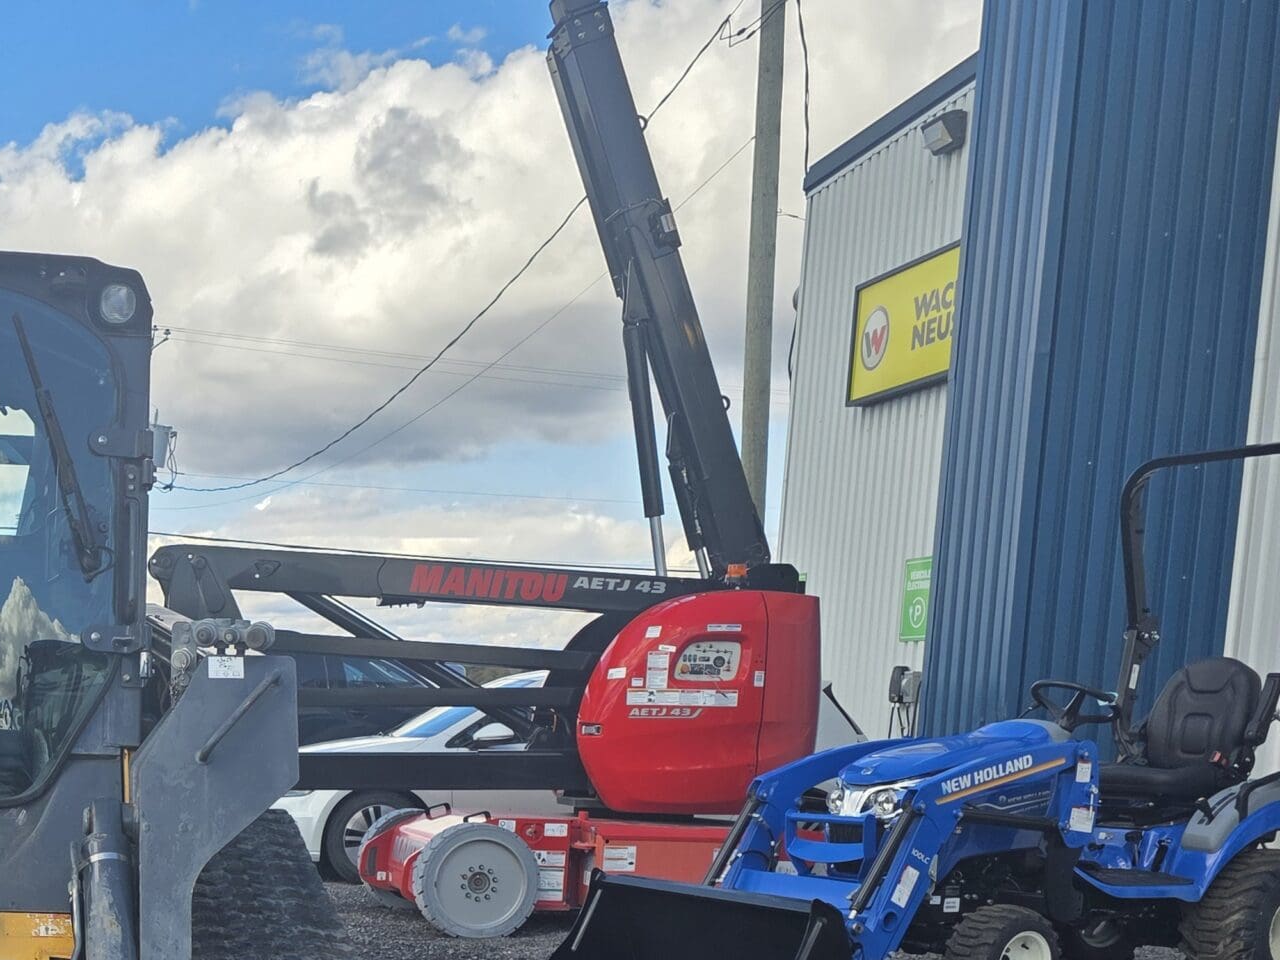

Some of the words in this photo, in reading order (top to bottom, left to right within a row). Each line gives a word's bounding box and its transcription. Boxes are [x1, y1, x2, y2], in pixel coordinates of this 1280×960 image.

[409, 563, 569, 602] MANITOU
[573, 576, 631, 592] AETJ
[634, 580, 667, 594] 43
[629, 707, 667, 716] AETJ
[671, 707, 692, 716] 43
[941, 773, 972, 795] NEW
[974, 754, 1033, 785] HOLLAND
